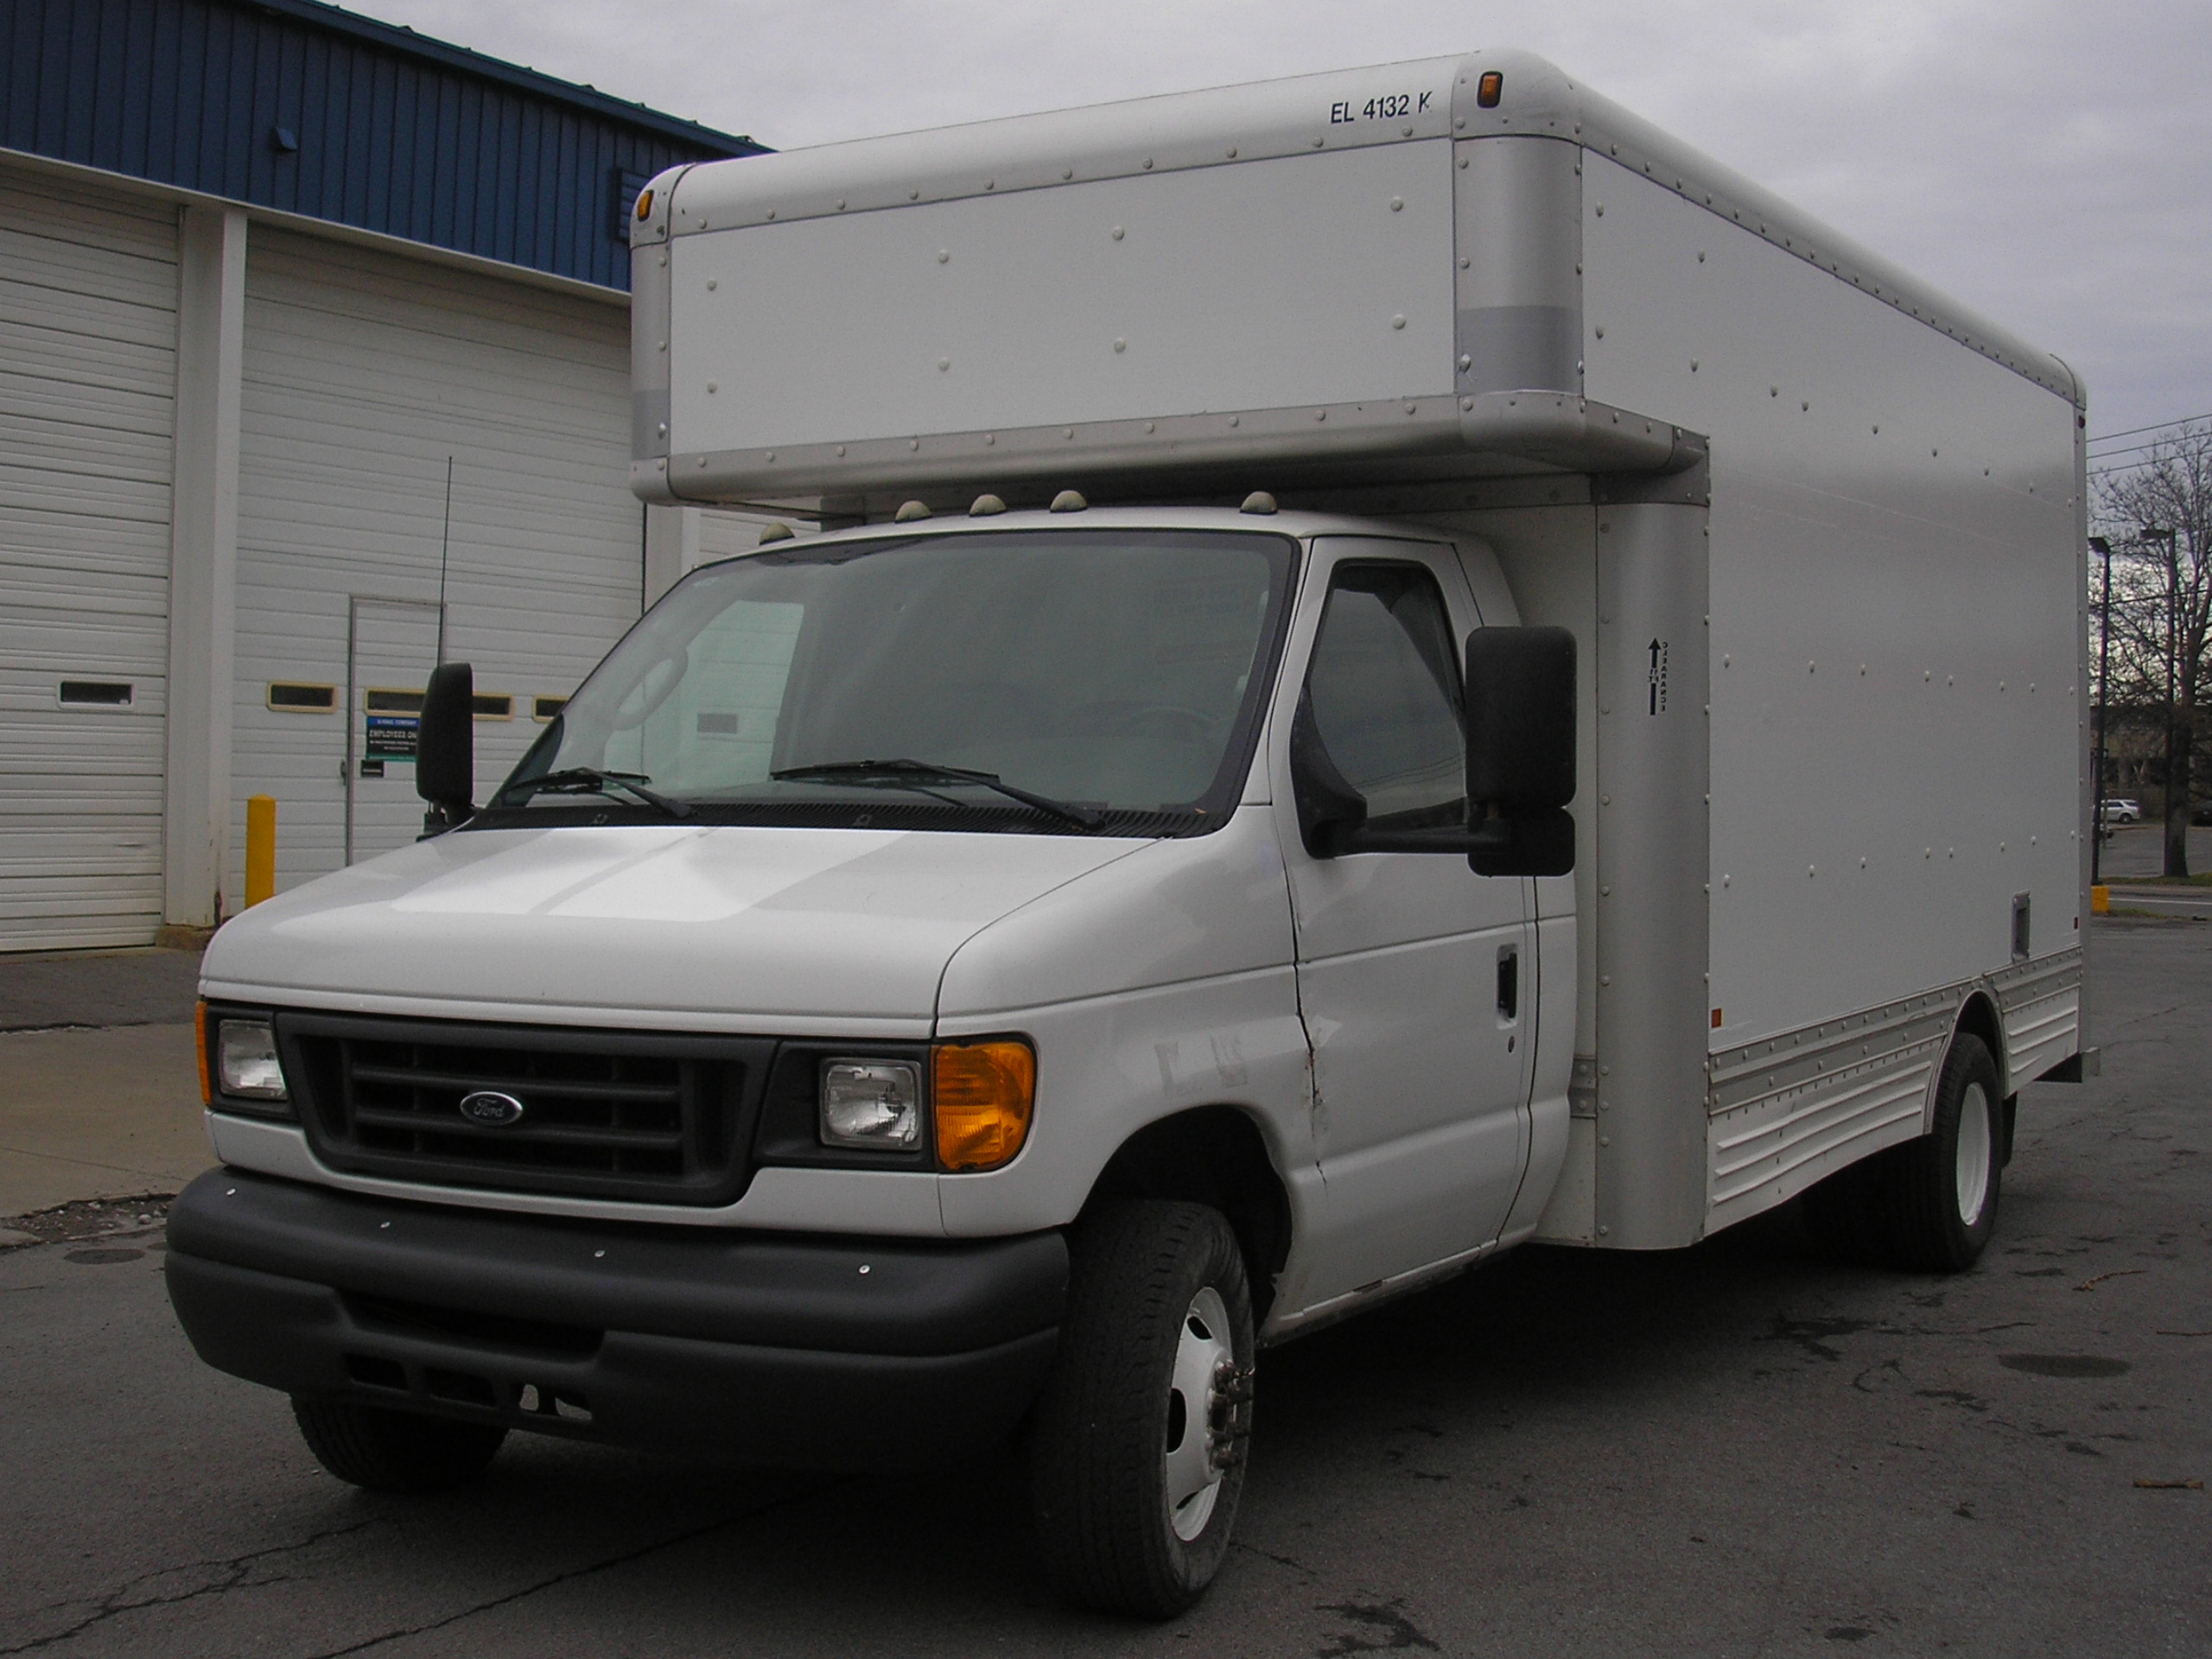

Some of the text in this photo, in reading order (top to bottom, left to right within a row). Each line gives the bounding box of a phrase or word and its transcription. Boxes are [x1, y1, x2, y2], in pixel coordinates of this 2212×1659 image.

[1331, 91, 1433, 124] EL 4132 K
[474, 1097, 506, 1117] Ford
